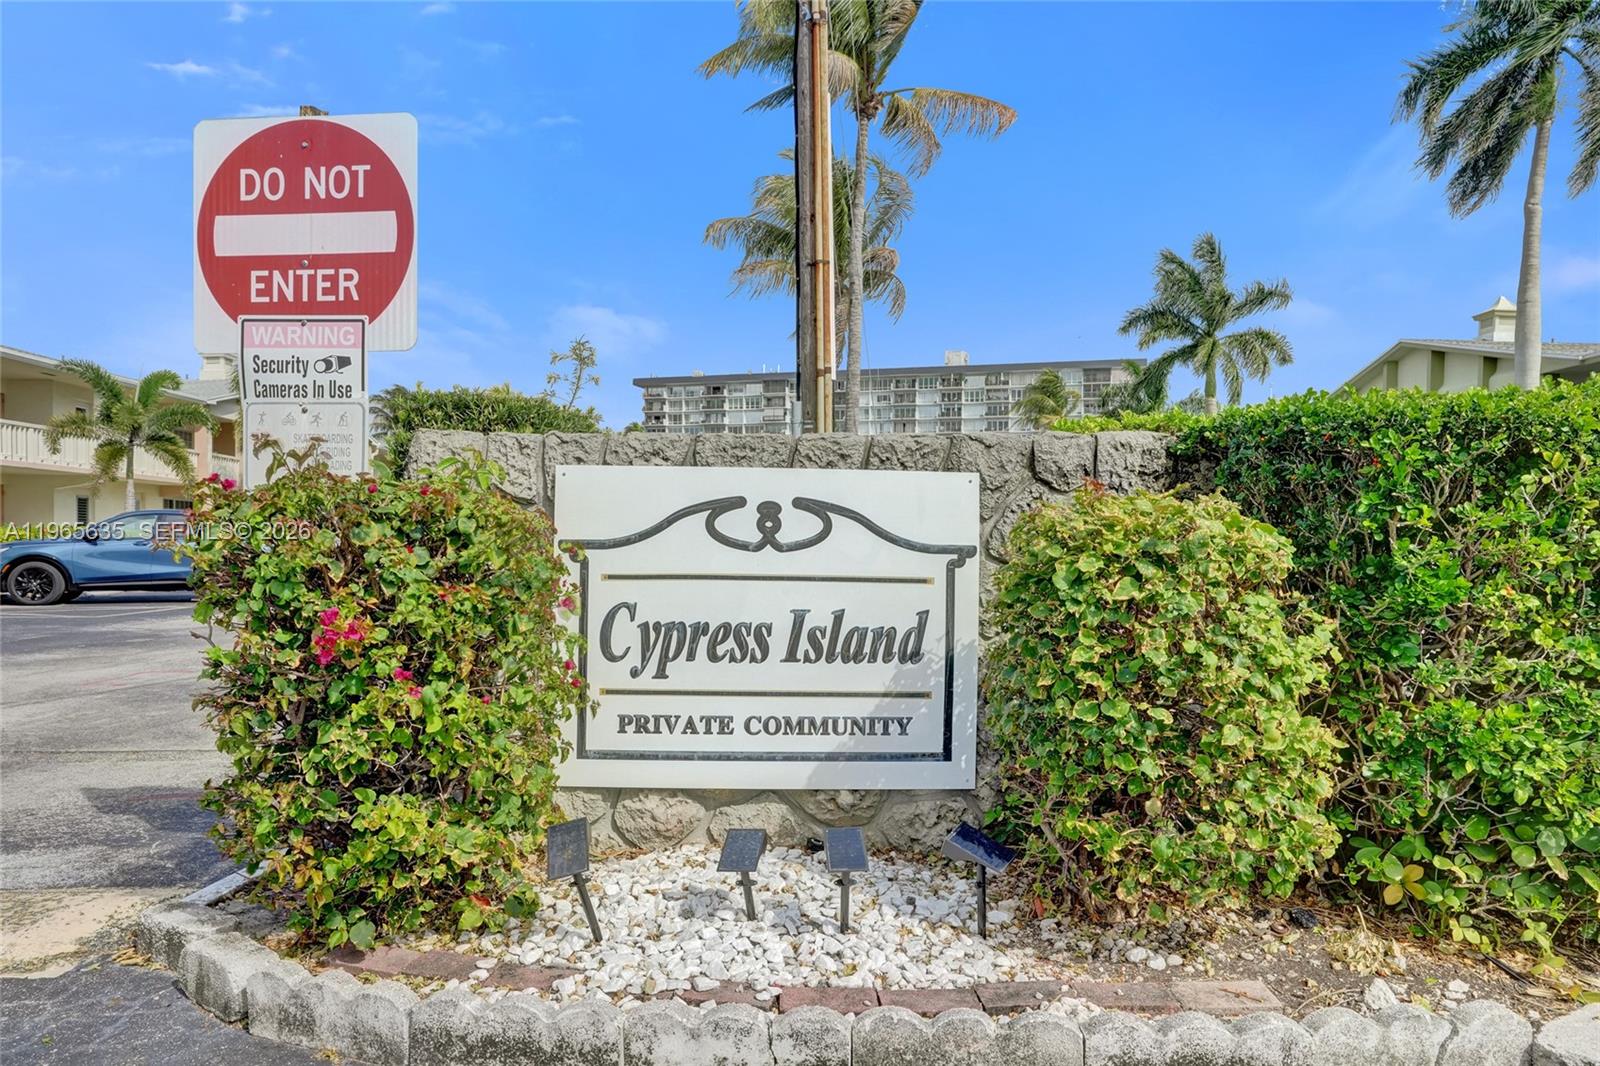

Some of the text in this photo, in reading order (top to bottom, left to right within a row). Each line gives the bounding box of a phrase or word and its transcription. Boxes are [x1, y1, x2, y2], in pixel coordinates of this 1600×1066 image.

[239, 165, 371, 201] DO NOT
[250, 268, 360, 303] ENTER
[251, 326, 355, 345] WARNING
[252, 354, 309, 378] Security
[253, 379, 353, 399] Cameras In Use
[599, 601, 931, 680] Cypress Island
[616, 713, 914, 737] PRIVATE COMMUNITY
